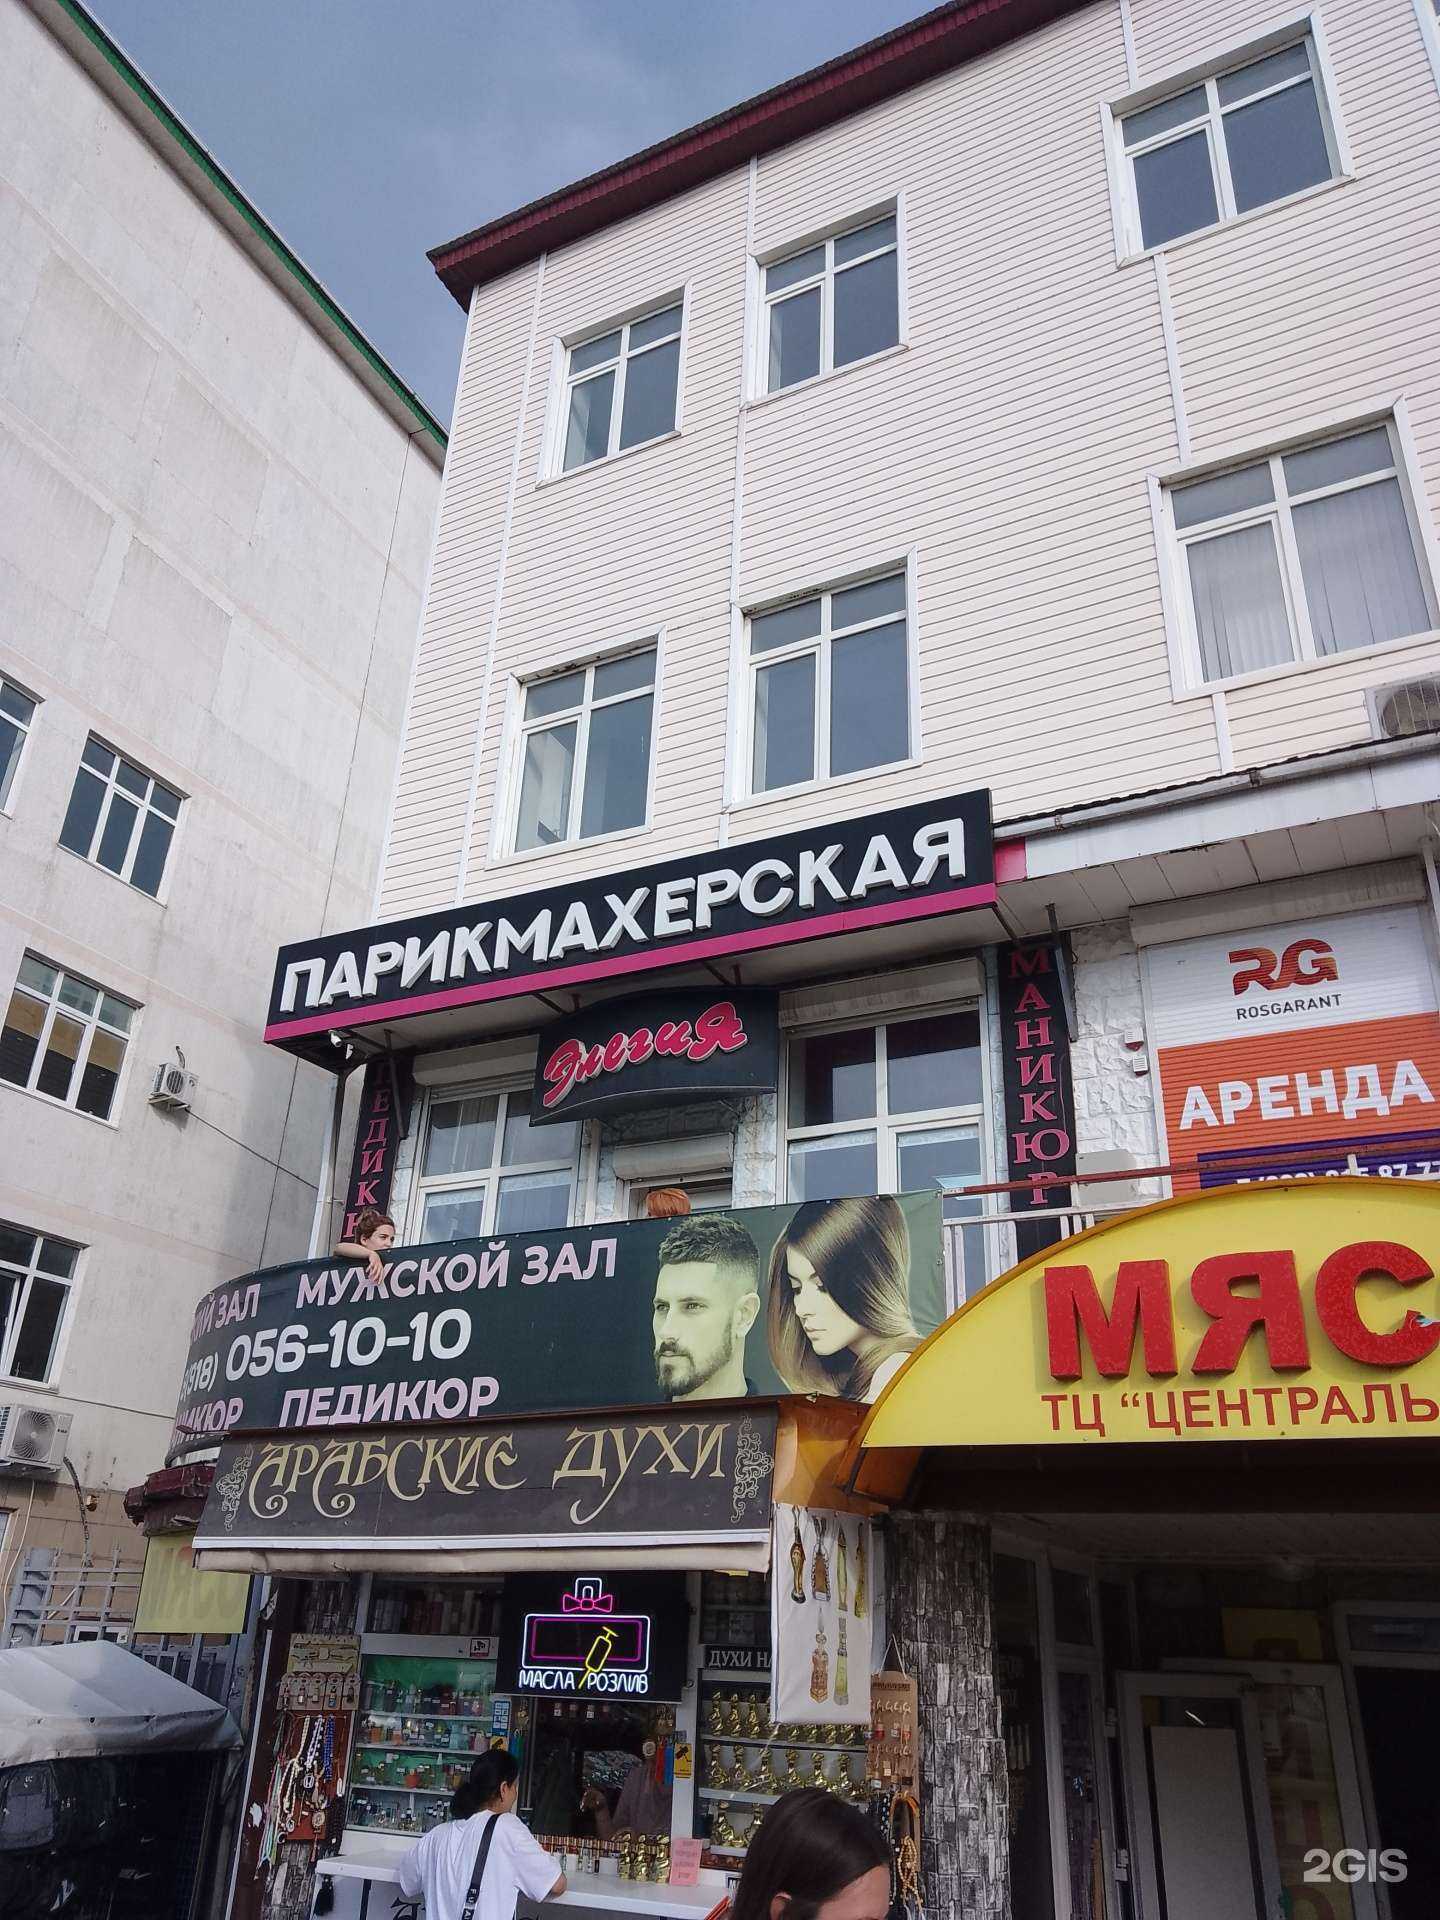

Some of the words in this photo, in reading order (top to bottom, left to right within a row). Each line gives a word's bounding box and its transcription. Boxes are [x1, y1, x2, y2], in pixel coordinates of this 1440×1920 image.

[279, 817, 966, 1012] ПАРИКМАХЕРСКАЯ
[1228, 939, 1339, 996] RG
[1236, 994, 1342, 1020] ROSGARANT
[1008, 948, 1070, 1206] МАНИКЮР
[1179, 1060, 1435, 1129] АРЕНДА
[295, 1241, 509, 1309] МУЖСКОЙ
[520, 1238, 617, 1286] ЗАЛ
[215, 1283, 262, 1329] ЗАЛ
[225, 1308, 472, 1382] 056-10-10
[279, 1376, 500, 1428] ПЕДИКЮР
[1041, 1393, 1106, 1437] ТЦ
[248, 1433, 527, 1519] АРАБСКИЕ
[552, 1423, 731, 1525] ДУХИ
[519, 1669, 576, 1690] МАСЛА
[586, 1671, 649, 1694] РОЗЛИВ
[708, 1650, 751, 1669] ДУХИ
